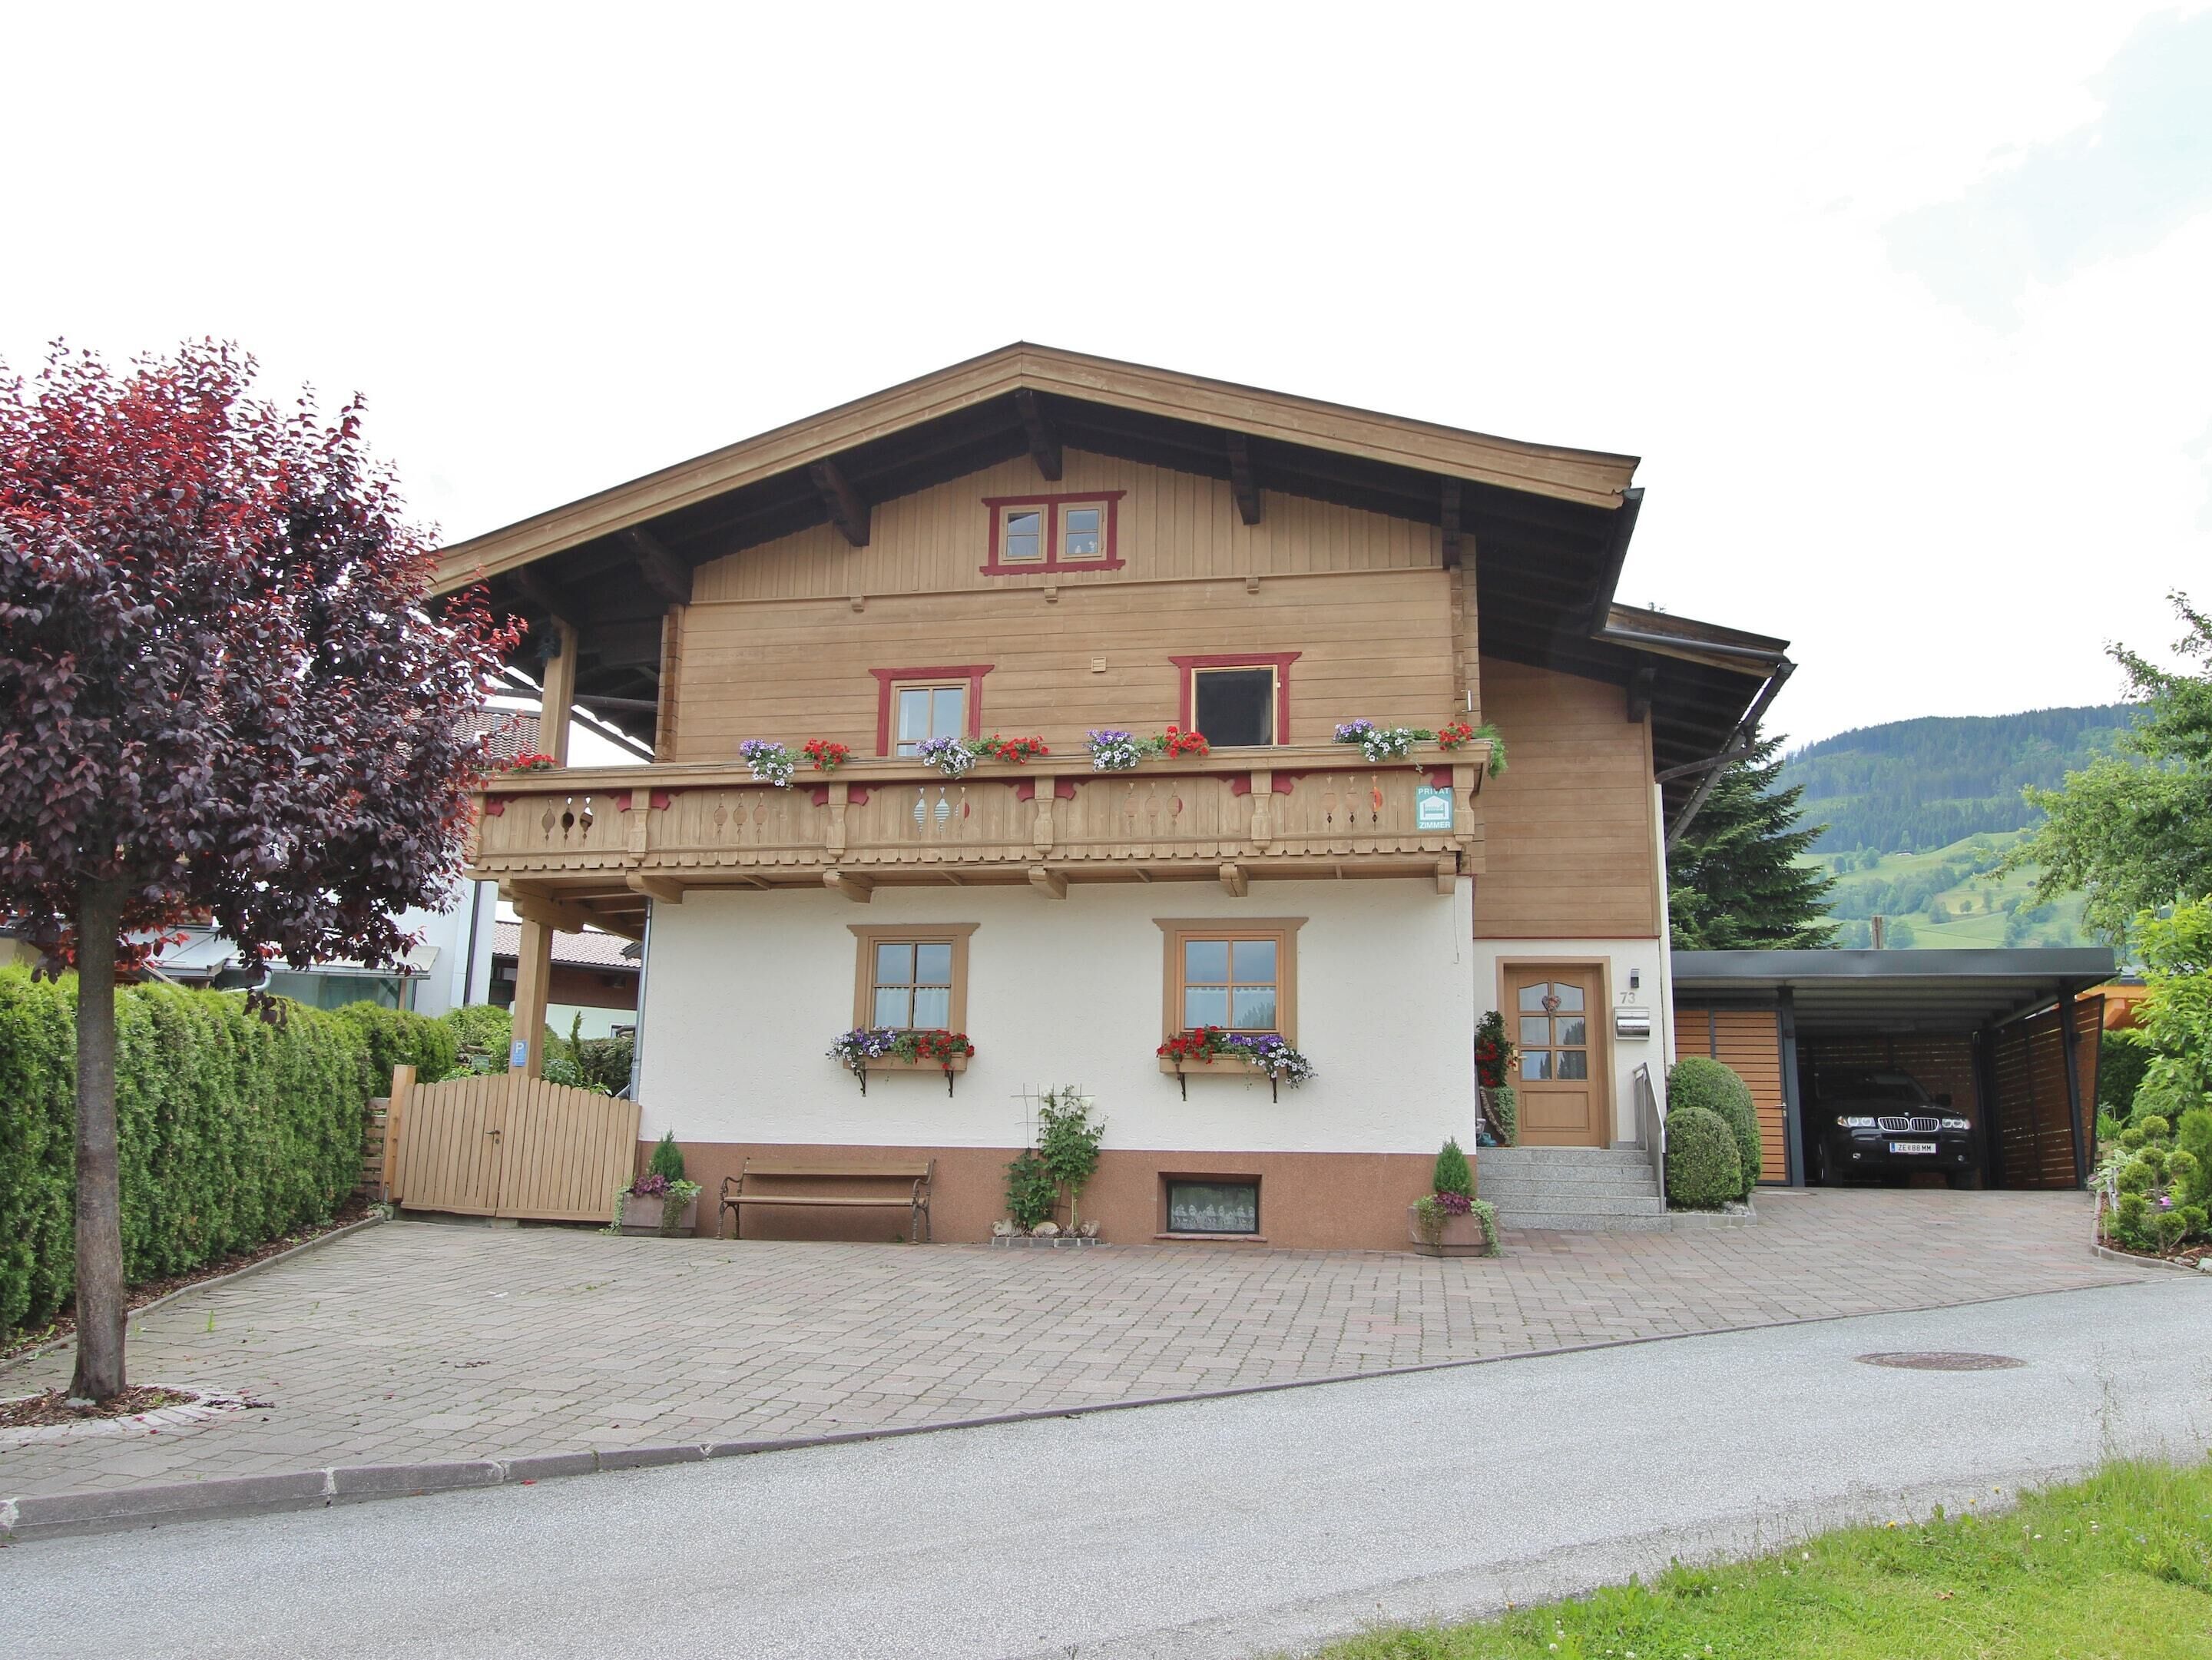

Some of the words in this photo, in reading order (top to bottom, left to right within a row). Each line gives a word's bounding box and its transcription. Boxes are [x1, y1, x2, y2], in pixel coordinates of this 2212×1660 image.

[1419, 821, 1451, 830] ZIMMER
[1619, 992, 1636, 1004] 73
[515, 1042, 525, 1054] P
